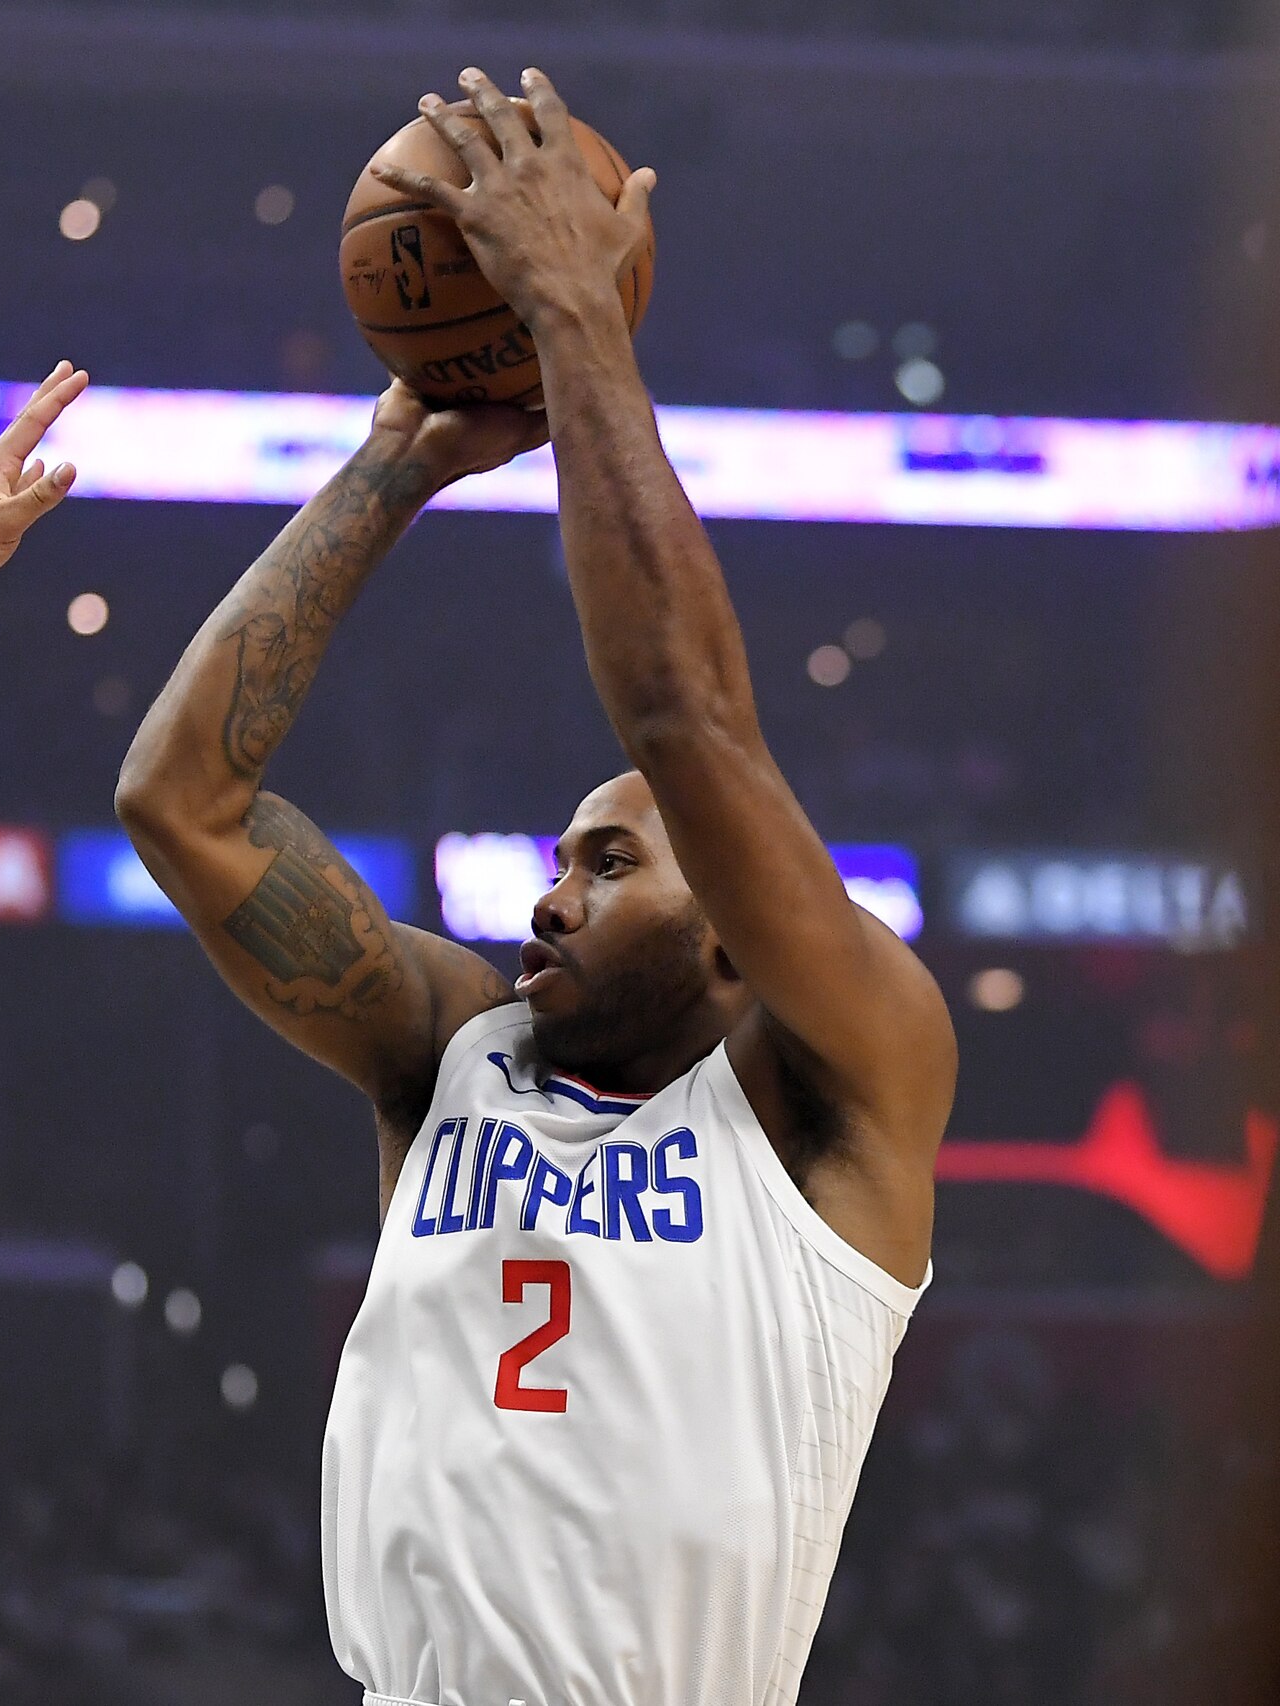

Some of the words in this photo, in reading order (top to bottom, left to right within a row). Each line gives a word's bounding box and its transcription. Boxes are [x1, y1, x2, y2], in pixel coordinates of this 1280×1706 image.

[424, 323, 532, 383] PALD
[410, 1117, 705, 1243] CLIPPERS
[494, 1259, 572, 1414] 2
